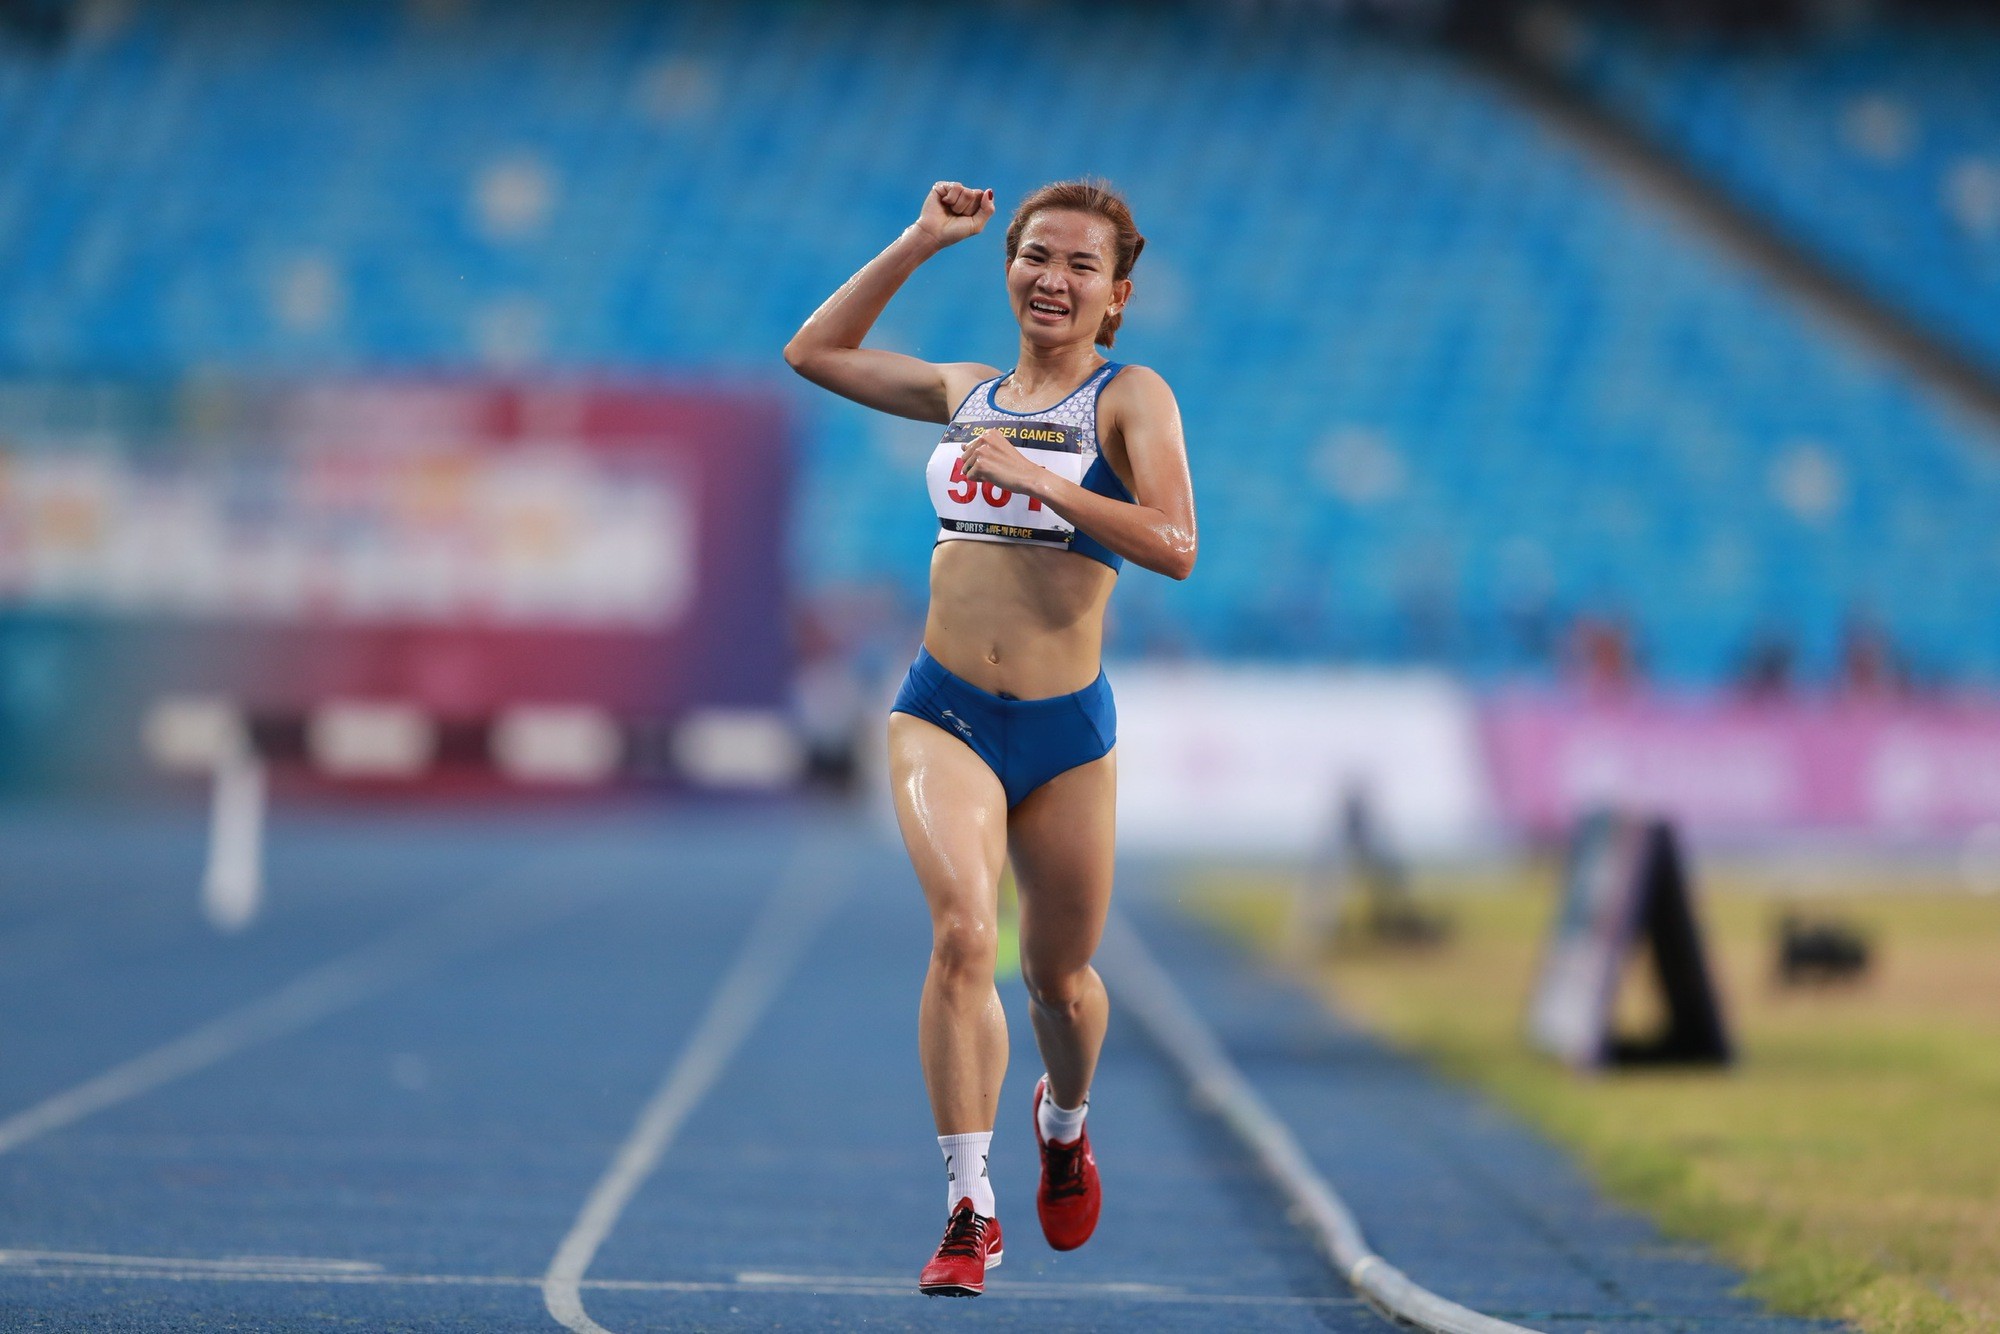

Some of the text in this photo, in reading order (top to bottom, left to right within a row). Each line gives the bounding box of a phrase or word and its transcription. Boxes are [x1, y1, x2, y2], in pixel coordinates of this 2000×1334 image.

[998, 427, 1017, 439] SEA
[1019, 428, 1065, 443] GAMES
[947, 457, 1044, 512] 56
[955, 521, 984, 533] SPORTS
[1009, 527, 1033, 538] PEACE
